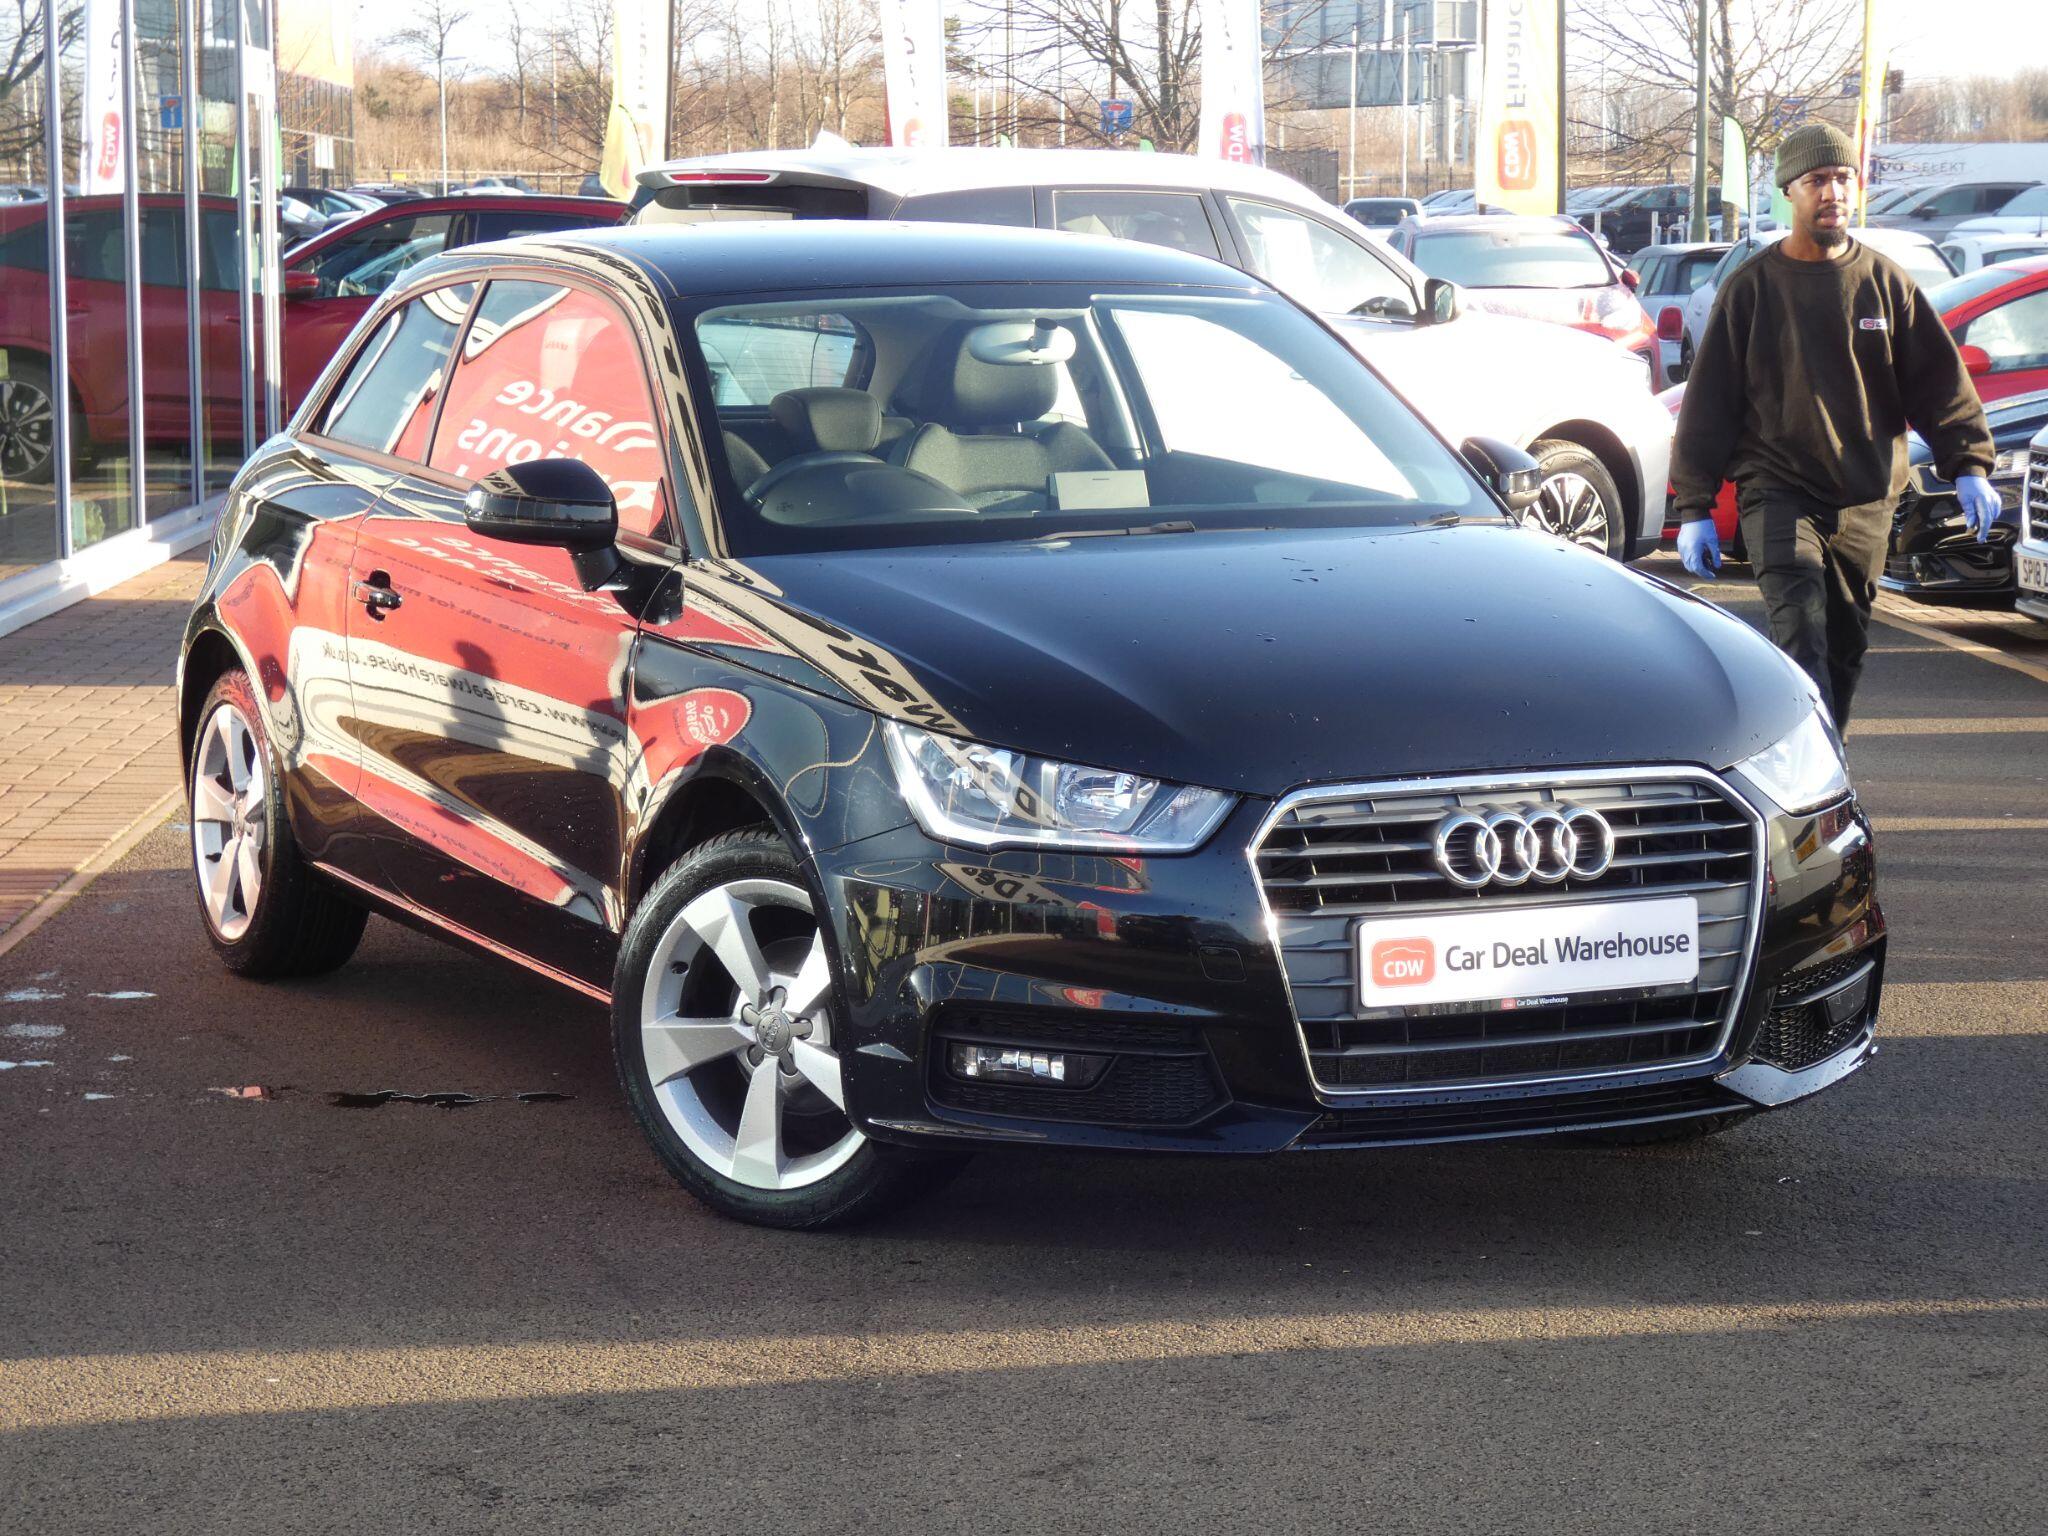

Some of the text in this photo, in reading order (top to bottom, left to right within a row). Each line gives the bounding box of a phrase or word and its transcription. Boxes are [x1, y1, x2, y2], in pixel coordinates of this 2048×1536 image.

[1383, 931, 1690, 979] CDW Car Deal Warehouse
[1516, 999, 1526, 1007] Car
[1526, 998, 1539, 1006] Deal
[1539, 996, 1569, 1005] Warehouse
